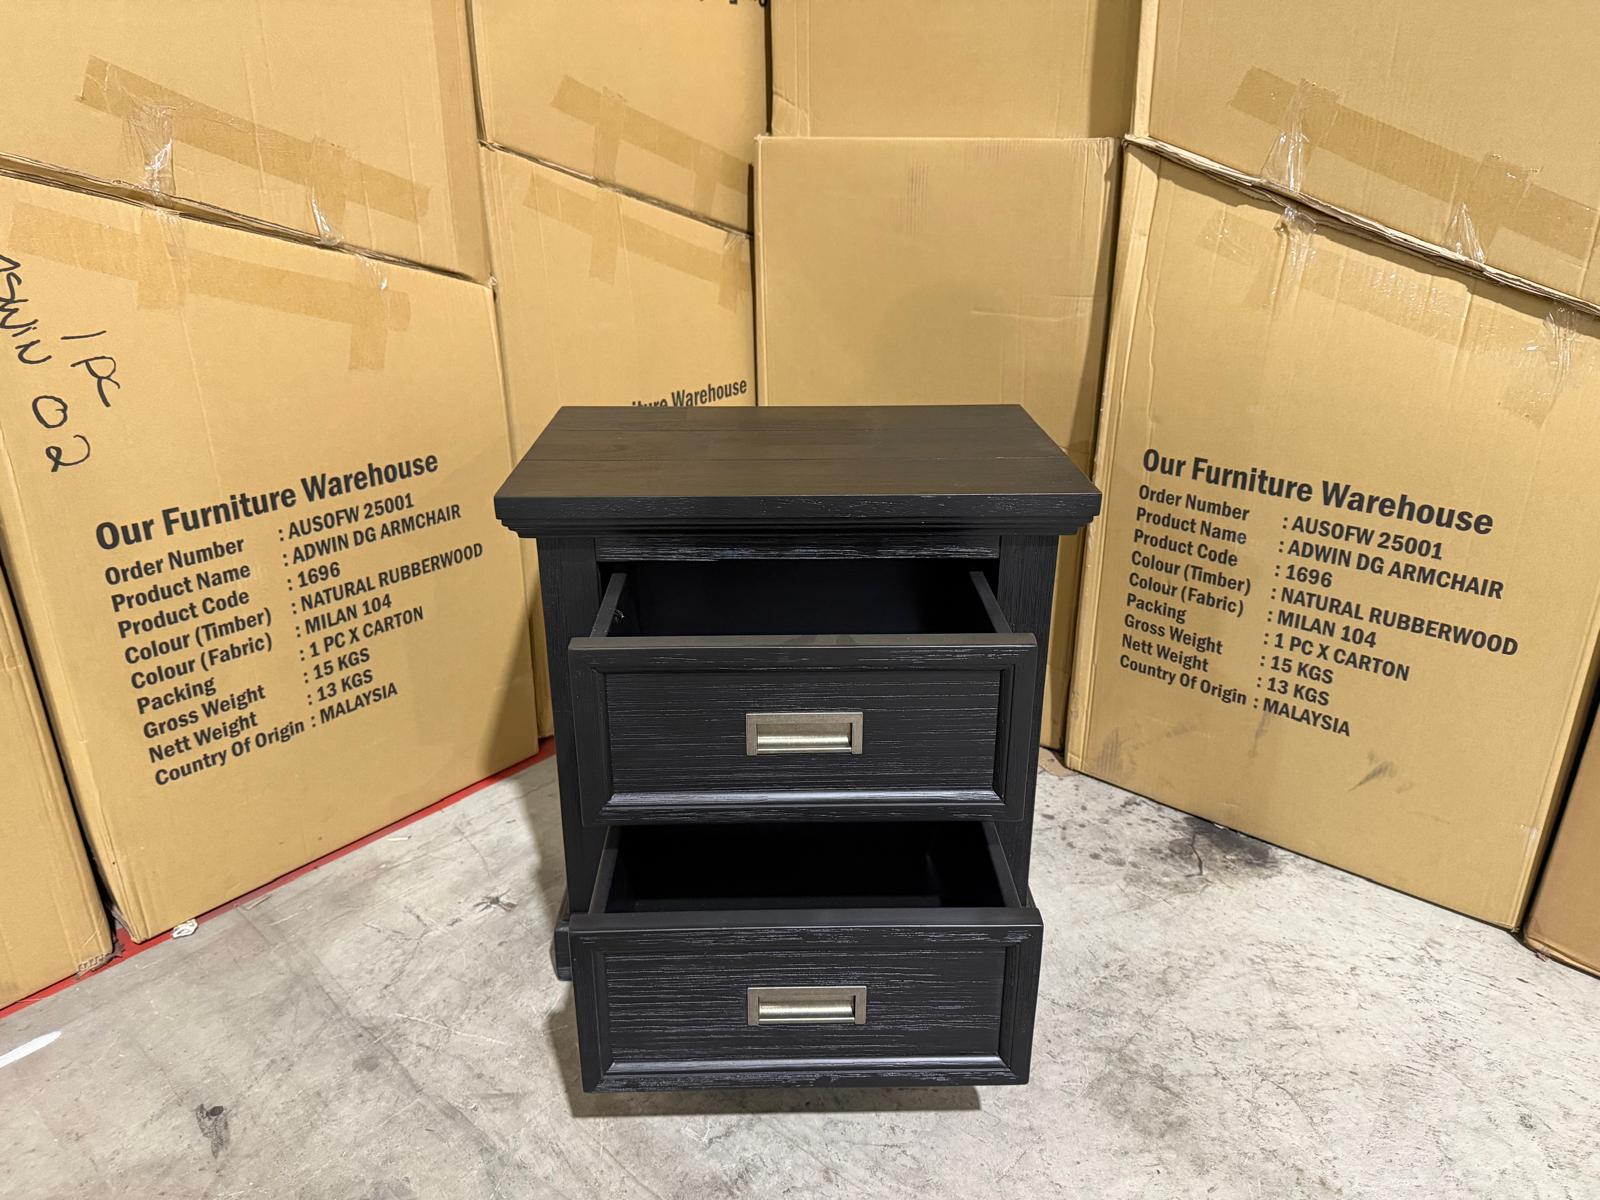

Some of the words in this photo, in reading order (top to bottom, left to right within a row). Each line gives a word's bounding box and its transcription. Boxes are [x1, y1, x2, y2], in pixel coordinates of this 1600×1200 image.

[671, 379, 748, 407] Warehouse
[96, 519, 154, 550] Our
[162, 489, 296, 536] Furniture
[300, 455, 438, 502] Warehouse
[1139, 485, 1182, 506] Order
[1185, 494, 1250, 520] Number
[1291, 516, 1375, 545] AUSOFW
[1377, 532, 1442, 560] 25001
[1144, 449, 1186, 477] Our
[1192, 457, 1312, 502] Furniture
[1322, 480, 1493, 534] Warehouse
[105, 559, 163, 585] Order
[168, 539, 244, 570] Number
[289, 506, 359, 539] AUSOFW
[364, 493, 414, 519] 25001
[111, 577, 193, 612] Product
[196, 565, 250, 590] Name
[293, 534, 349, 564] ADWIN
[353, 527, 376, 546] DG
[381, 504, 461, 539] ARMCHAIR
[1134, 529, 1193, 555] Product
[1197, 544, 1238, 566] Code
[1286, 564, 1332, 587] 1696
[1136, 507, 1196, 533] Product
[1200, 521, 1246, 544] Name
[1287, 540, 1351, 567] ADWIN
[1356, 553, 1384, 574] DG
[1387, 561, 1504, 599] ARMCHAIR
[118, 603, 199, 638] Product
[202, 592, 249, 614] Code
[298, 562, 340, 587] 1696
[125, 634, 190, 664] Colour
[195, 608, 271, 647] (Timber)
[301, 576, 376, 611] NATURAL
[378, 543, 482, 587] RUBBERWOOD
[131, 659, 195, 689] Colour
[201, 632, 272, 671] (Fabric)
[305, 604, 357, 634] MILAN
[363, 594, 392, 616] 104
[1126, 594, 1186, 624] Packing
[1275, 632, 1283, 648] 1
[1289, 636, 1313, 655] PC
[1316, 643, 1330, 660] X
[1334, 649, 1410, 681] CARTON
[1129, 573, 1177, 597] Colour
[1181, 586, 1243, 617] (Fabric)
[1277, 610, 1335, 637] MILAN
[1341, 626, 1376, 648] 104
[1132, 551, 1180, 575] Colour
[1184, 564, 1251, 596] (Timber)
[1281, 587, 1363, 620] NATURAL
[1369, 607, 1518, 656] RUBBERWOOD
[137, 677, 216, 714] Packing
[310, 642, 320, 657] 1
[324, 632, 345, 652] PC
[349, 627, 360, 644] X
[363, 606, 424, 638] CARTON
[144, 711, 199, 738] Gross
[201, 685, 266, 718] Weight
[313, 660, 334, 680] 15
[338, 648, 370, 671] KGS
[1122, 634, 1153, 656] Nett
[1157, 644, 1208, 672] Weight
[1267, 677, 1288, 694] 13
[1294, 684, 1329, 706] KGS
[1124, 614, 1165, 637] Gross
[1170, 626, 1223, 655] Weight
[1271, 656, 1292, 673] 15
[1297, 662, 1333, 684] KGS
[149, 736, 192, 763] Nett
[194, 712, 258, 746] Weight
[317, 682, 337, 701] 13
[341, 669, 373, 692] KGS
[155, 750, 227, 785] Country
[231, 737, 251, 757] Of
[255, 722, 304, 748] Origin
[320, 683, 397, 724] MALAYSIA
[1120, 655, 1176, 685] Country
[1180, 673, 1197, 689] Of
[1200, 680, 1246, 706] Origin
[1263, 698, 1350, 736] MALAYSIA
